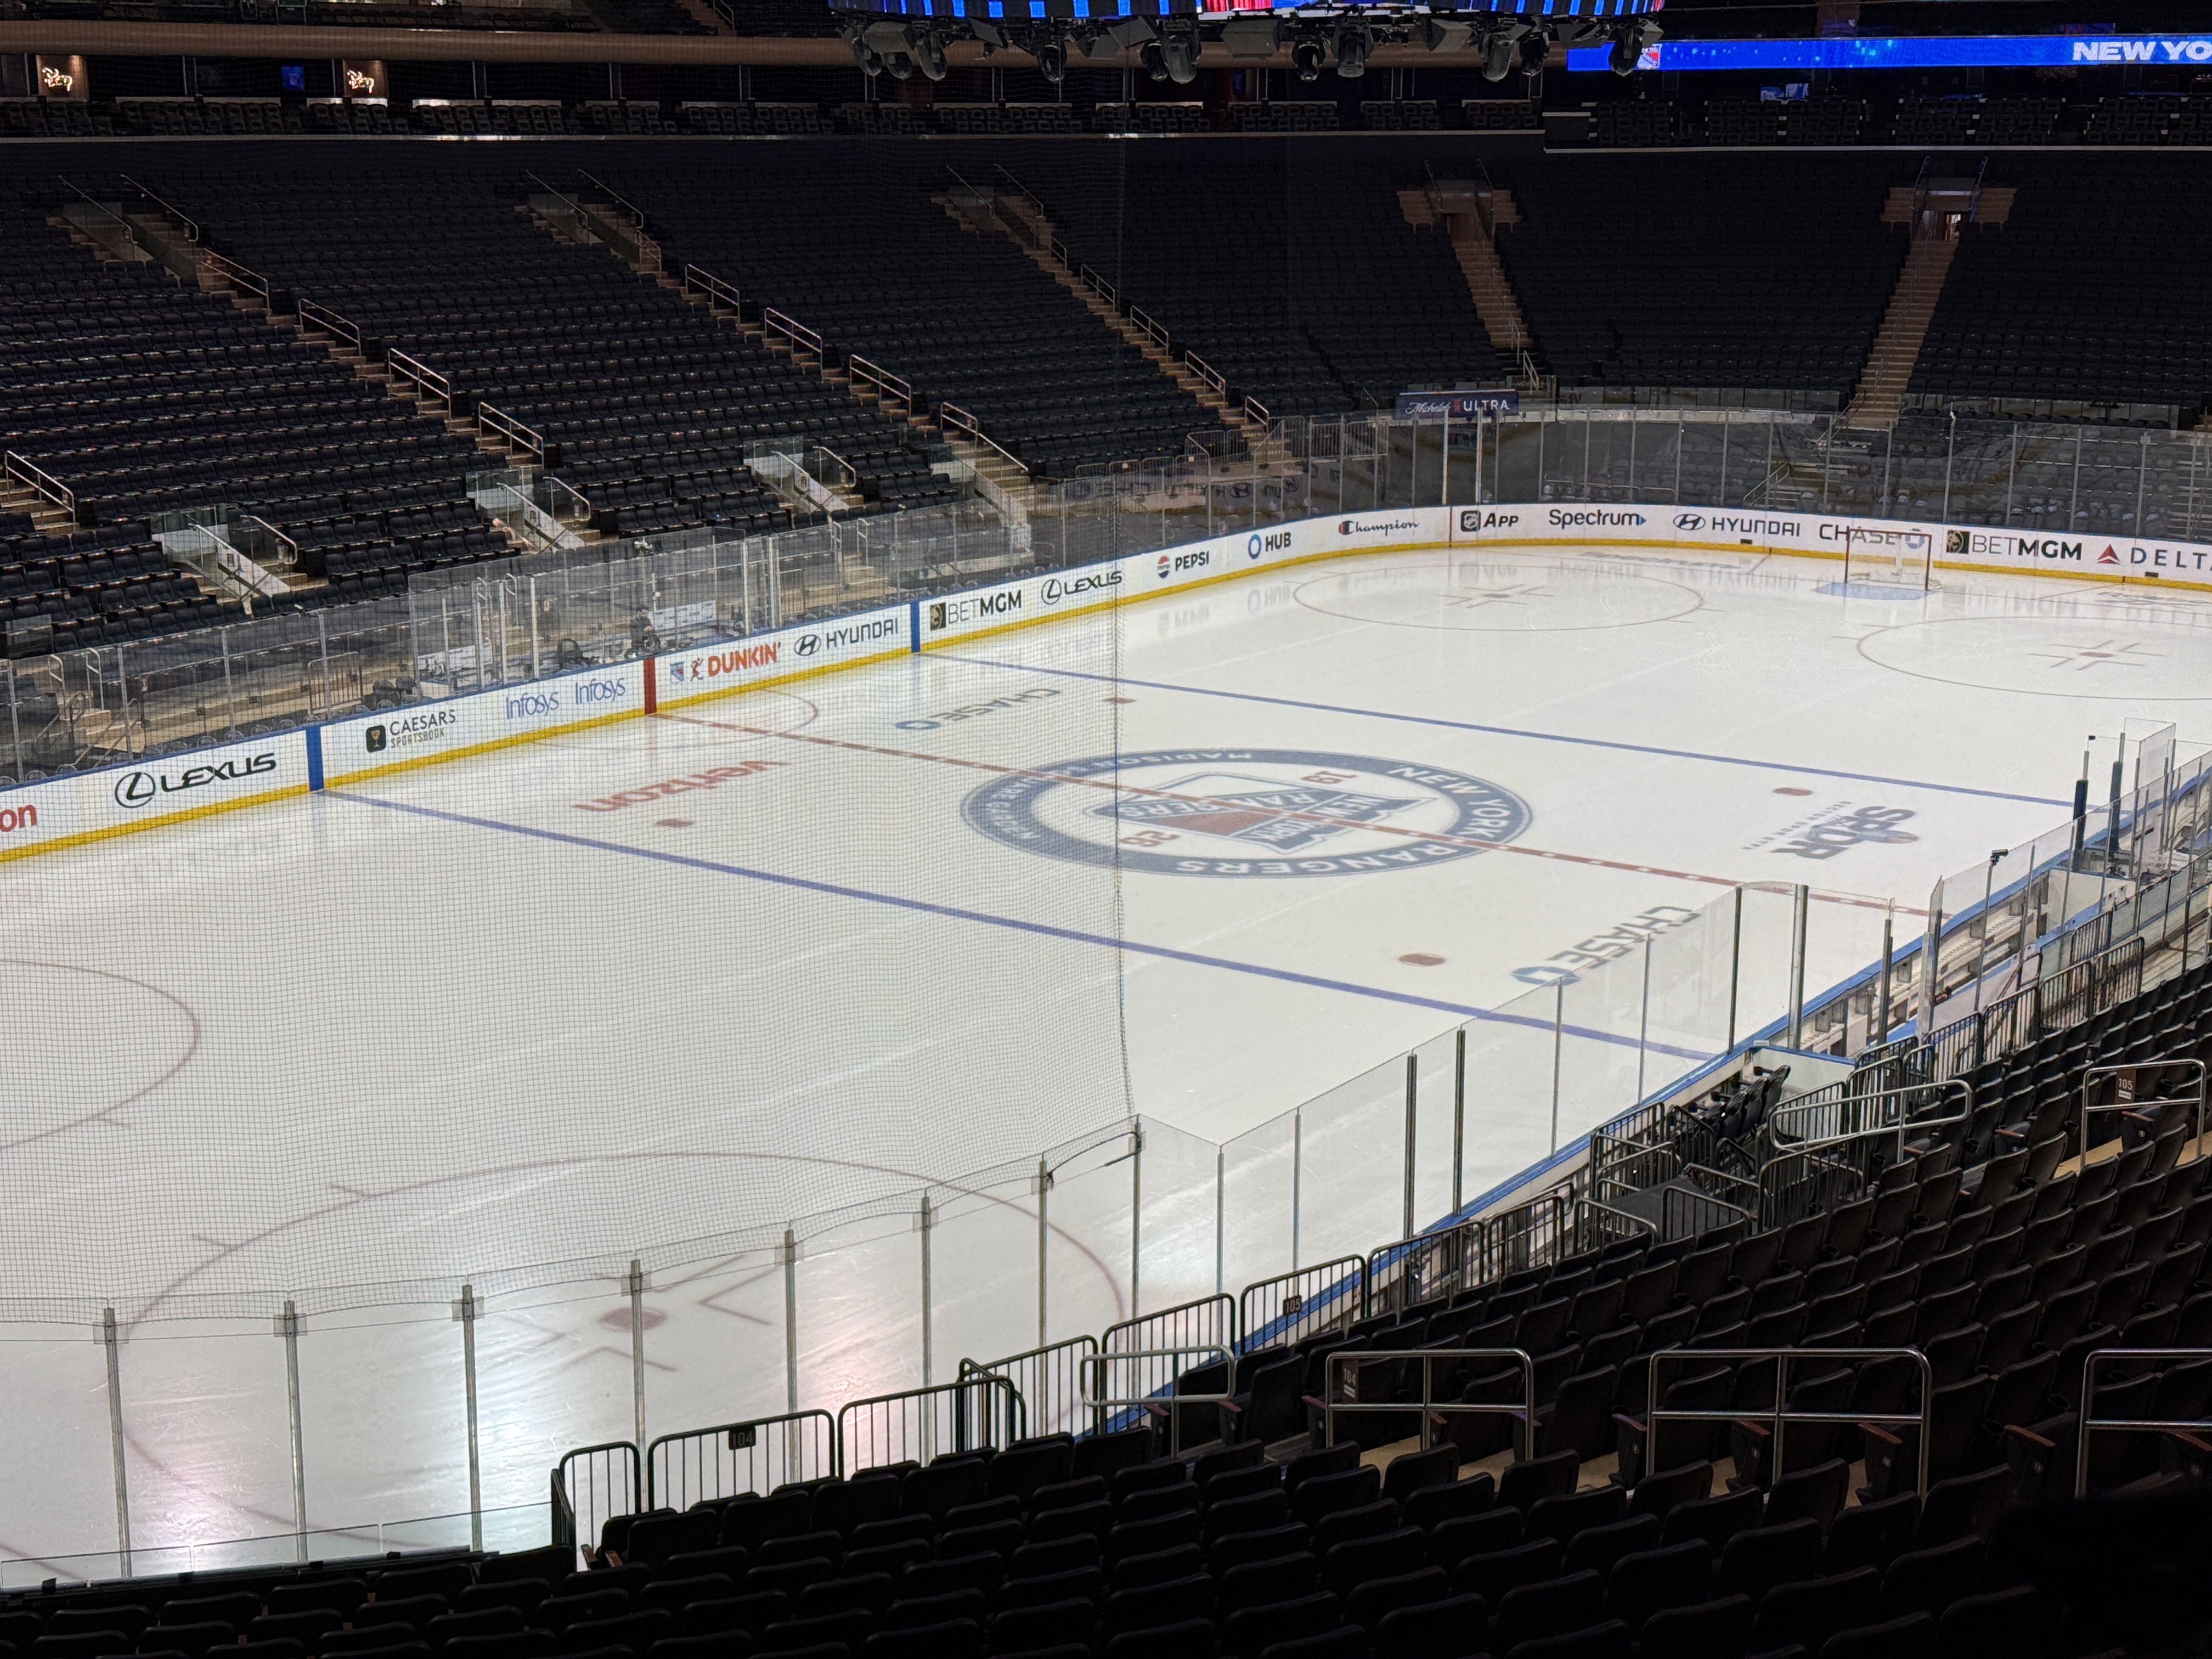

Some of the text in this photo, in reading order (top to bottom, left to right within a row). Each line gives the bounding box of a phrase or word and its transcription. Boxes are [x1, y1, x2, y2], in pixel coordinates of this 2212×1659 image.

[2072, 41, 2157, 61] NEW
[1405, 399, 1510, 414] Michelob ULTRA
[1338, 519, 1419, 537] Champion
[1549, 509, 1640, 529] Spectrum
[1712, 516, 1801, 538] HYUNDAI
[1265, 531, 1292, 552] HUB
[1972, 533, 2083, 561] BETMGM
[1175, 550, 1210, 572] PEPSI
[2130, 546, 2212, 571] DELT
[1064, 570, 1123, 596] LEXUS
[948, 590, 1022, 624] BETMGM
[826, 618, 899, 650] HYUNDAI
[708, 641, 782, 677] DUNKIN'
[574, 677, 625, 706] Infosys
[506, 691, 560, 720] Infosys
[390, 709, 456, 736] CAESARS
[391, 726, 445, 749] SPORTSBOOK
[161, 752, 276, 793] LEXUS
[1175, 765, 1512, 874] NEW YORK RANGERS
[1545, 905, 1702, 969] CHASE
[2118, 1077, 2133, 1091] 105
[1285, 1298, 1301, 1313] 105
[1343, 1368, 1357, 1387] 104
[731, 1430, 753, 1448] 104
